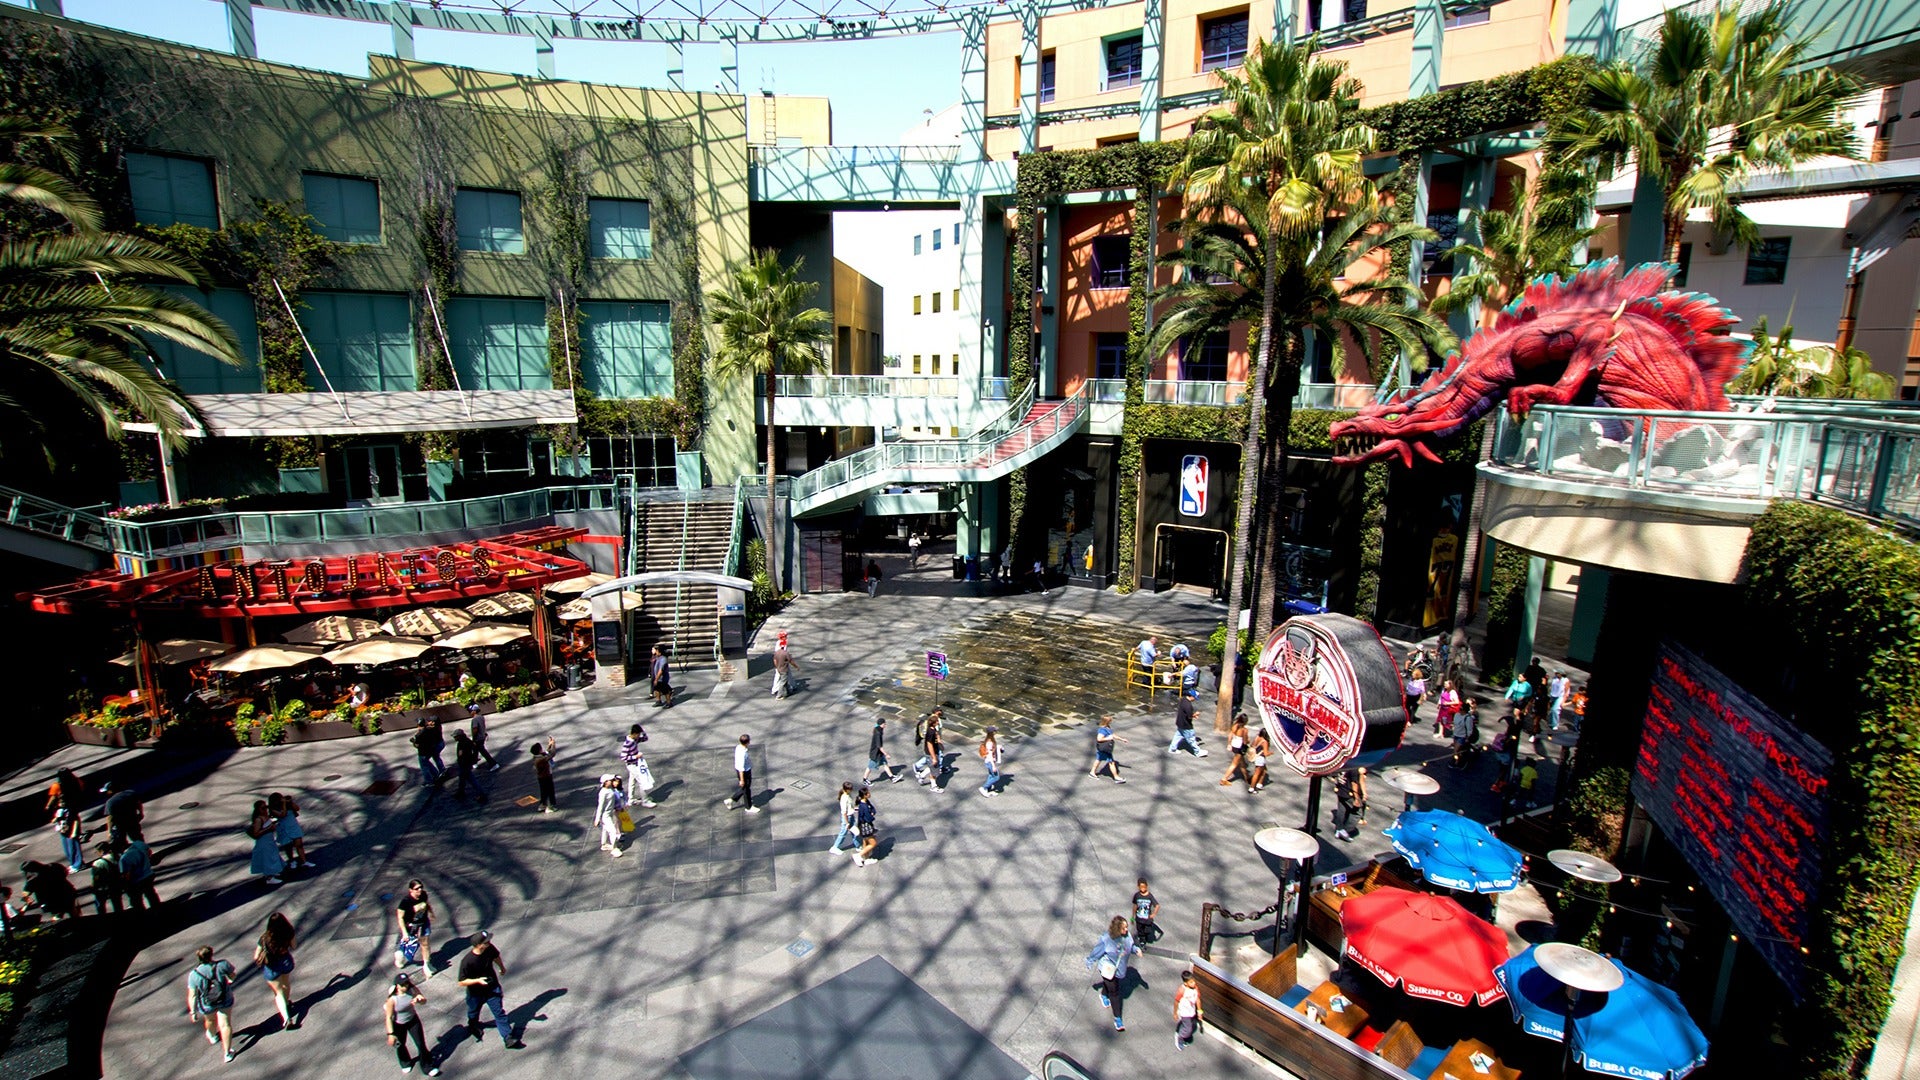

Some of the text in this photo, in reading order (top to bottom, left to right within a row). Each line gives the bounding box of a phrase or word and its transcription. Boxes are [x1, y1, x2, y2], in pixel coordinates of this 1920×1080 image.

[199, 547, 493, 602] ANTOJITOS
[1261, 676, 1304, 713] BUBBA
[1305, 695, 1350, 739] GUMP
[1408, 983, 1445, 997] SHRIMP
[1588, 1058, 1626, 1074] BUBBA
[1628, 1065, 1666, 1080] GUMP
